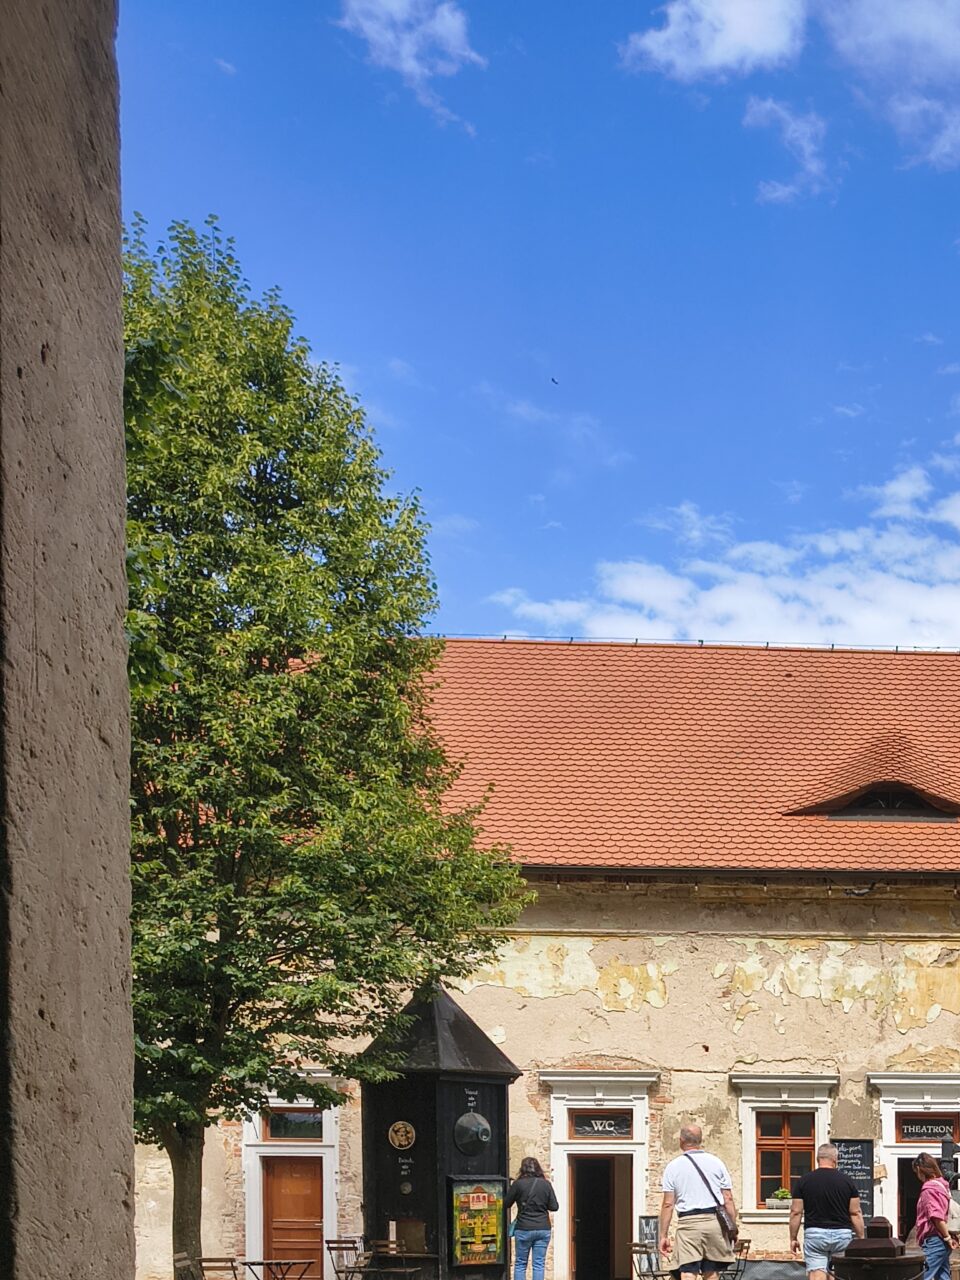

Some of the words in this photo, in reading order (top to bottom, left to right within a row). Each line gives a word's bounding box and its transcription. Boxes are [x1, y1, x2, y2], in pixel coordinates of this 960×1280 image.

[591, 1120, 615, 1131] WC
[902, 1125, 953, 1133] THEATRON
[641, 1218, 656, 1233] WC
